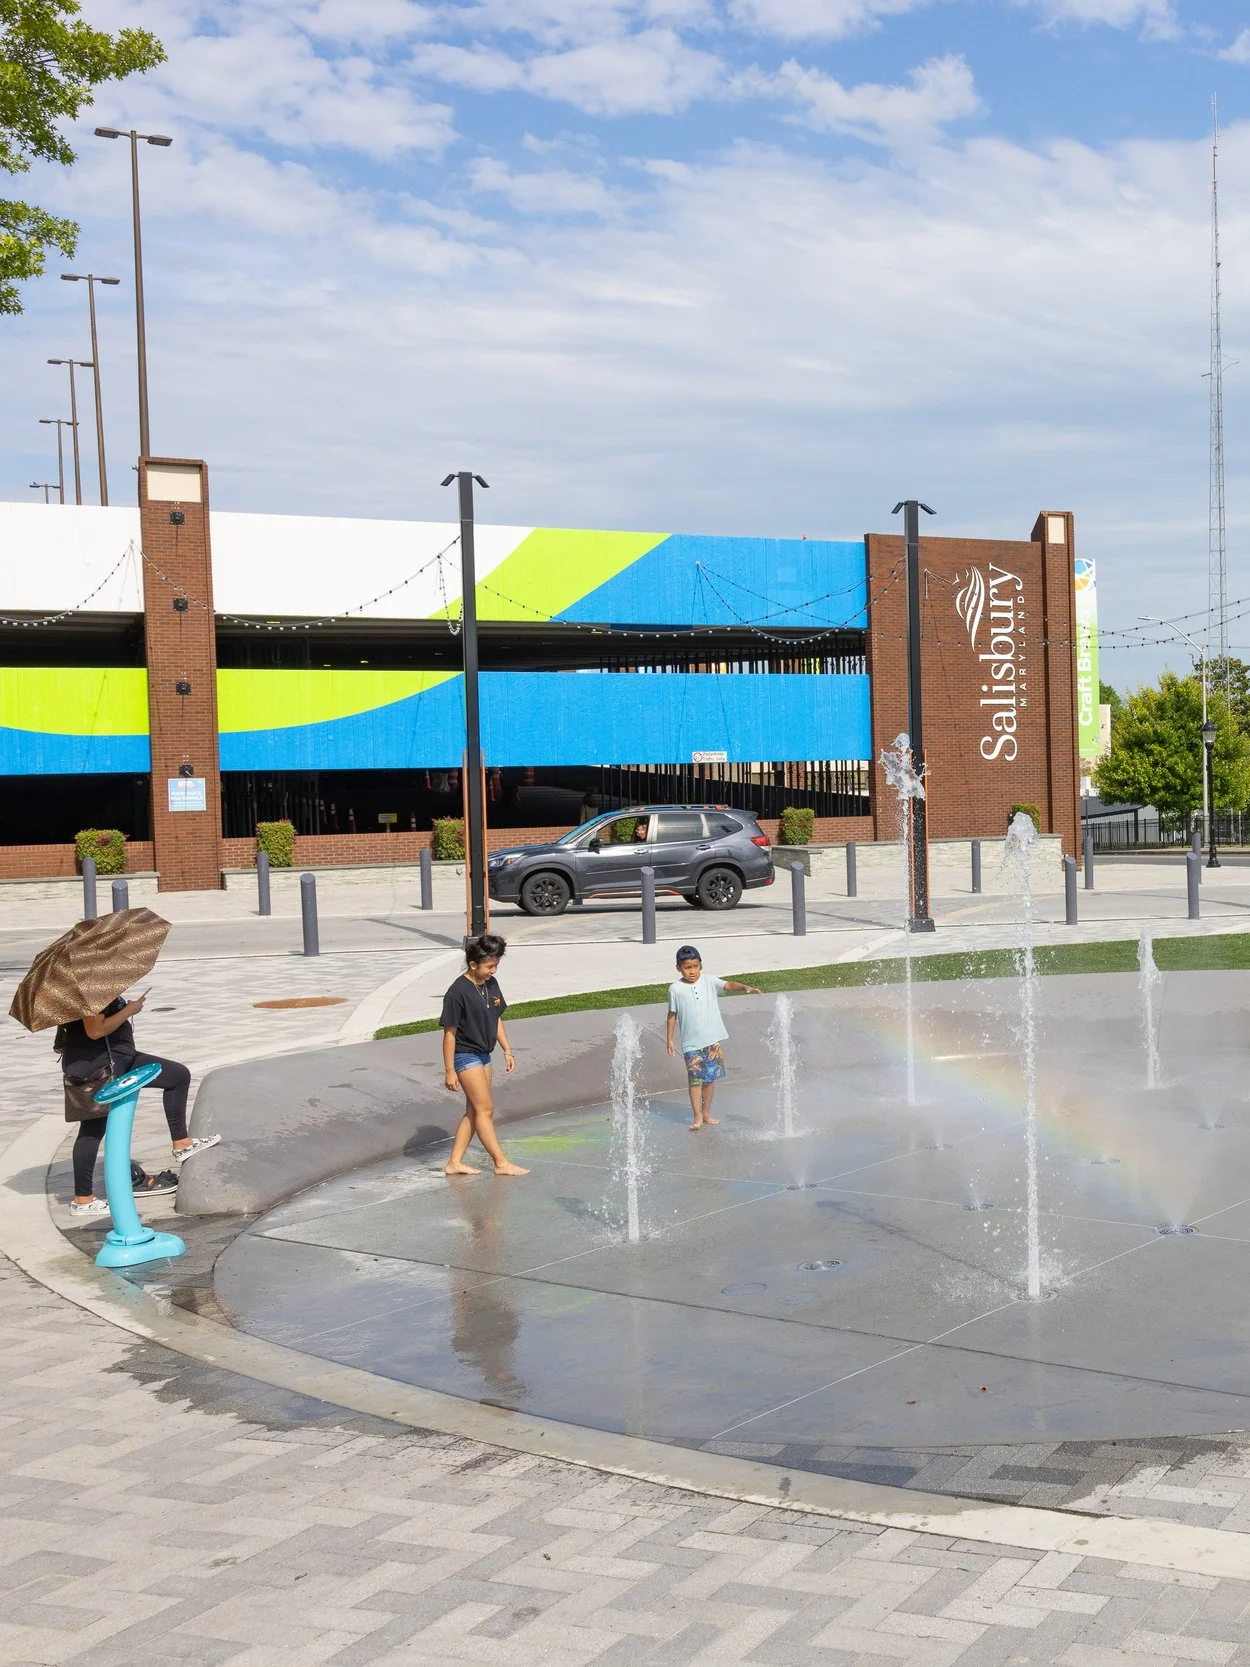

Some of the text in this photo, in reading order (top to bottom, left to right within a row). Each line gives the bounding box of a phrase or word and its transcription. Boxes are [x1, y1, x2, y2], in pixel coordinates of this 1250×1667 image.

[979, 562, 1024, 762] Salisbury
[1016, 596, 1028, 707] MARYLAND
[1077, 674, 1094, 726] Craft
